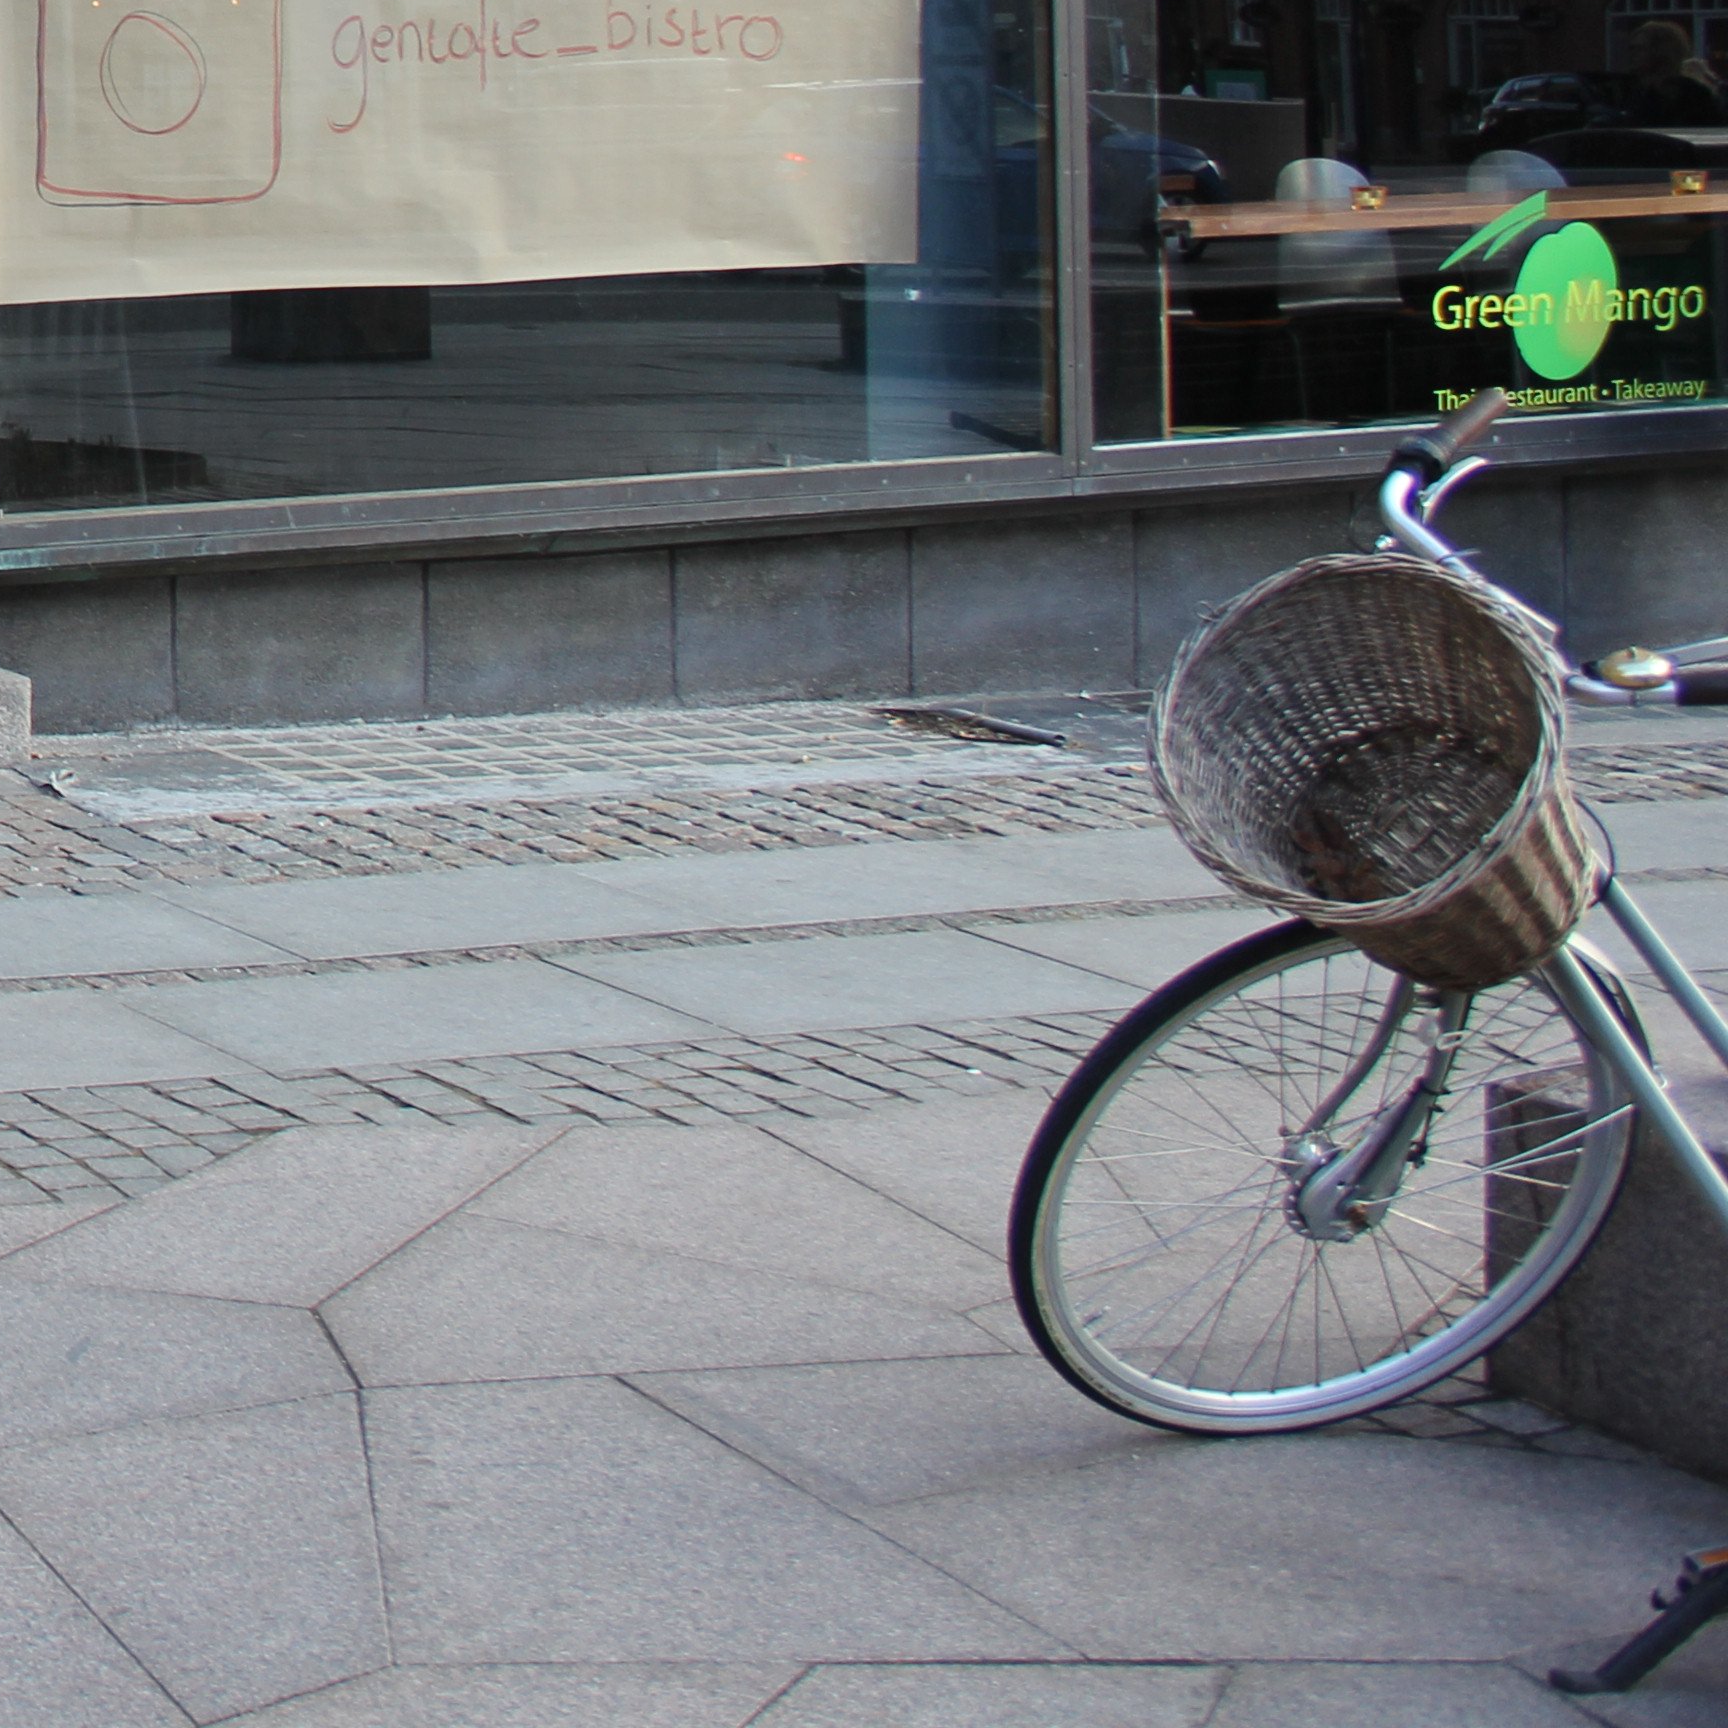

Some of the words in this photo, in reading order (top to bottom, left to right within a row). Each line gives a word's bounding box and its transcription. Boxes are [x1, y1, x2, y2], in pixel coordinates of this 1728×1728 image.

[1432, 285, 1555, 331] Green
[1567, 278, 1708, 332] Mango
[1493, 383, 1598, 409] estaurant
[1610, 378, 1707, 401] Takeaway
